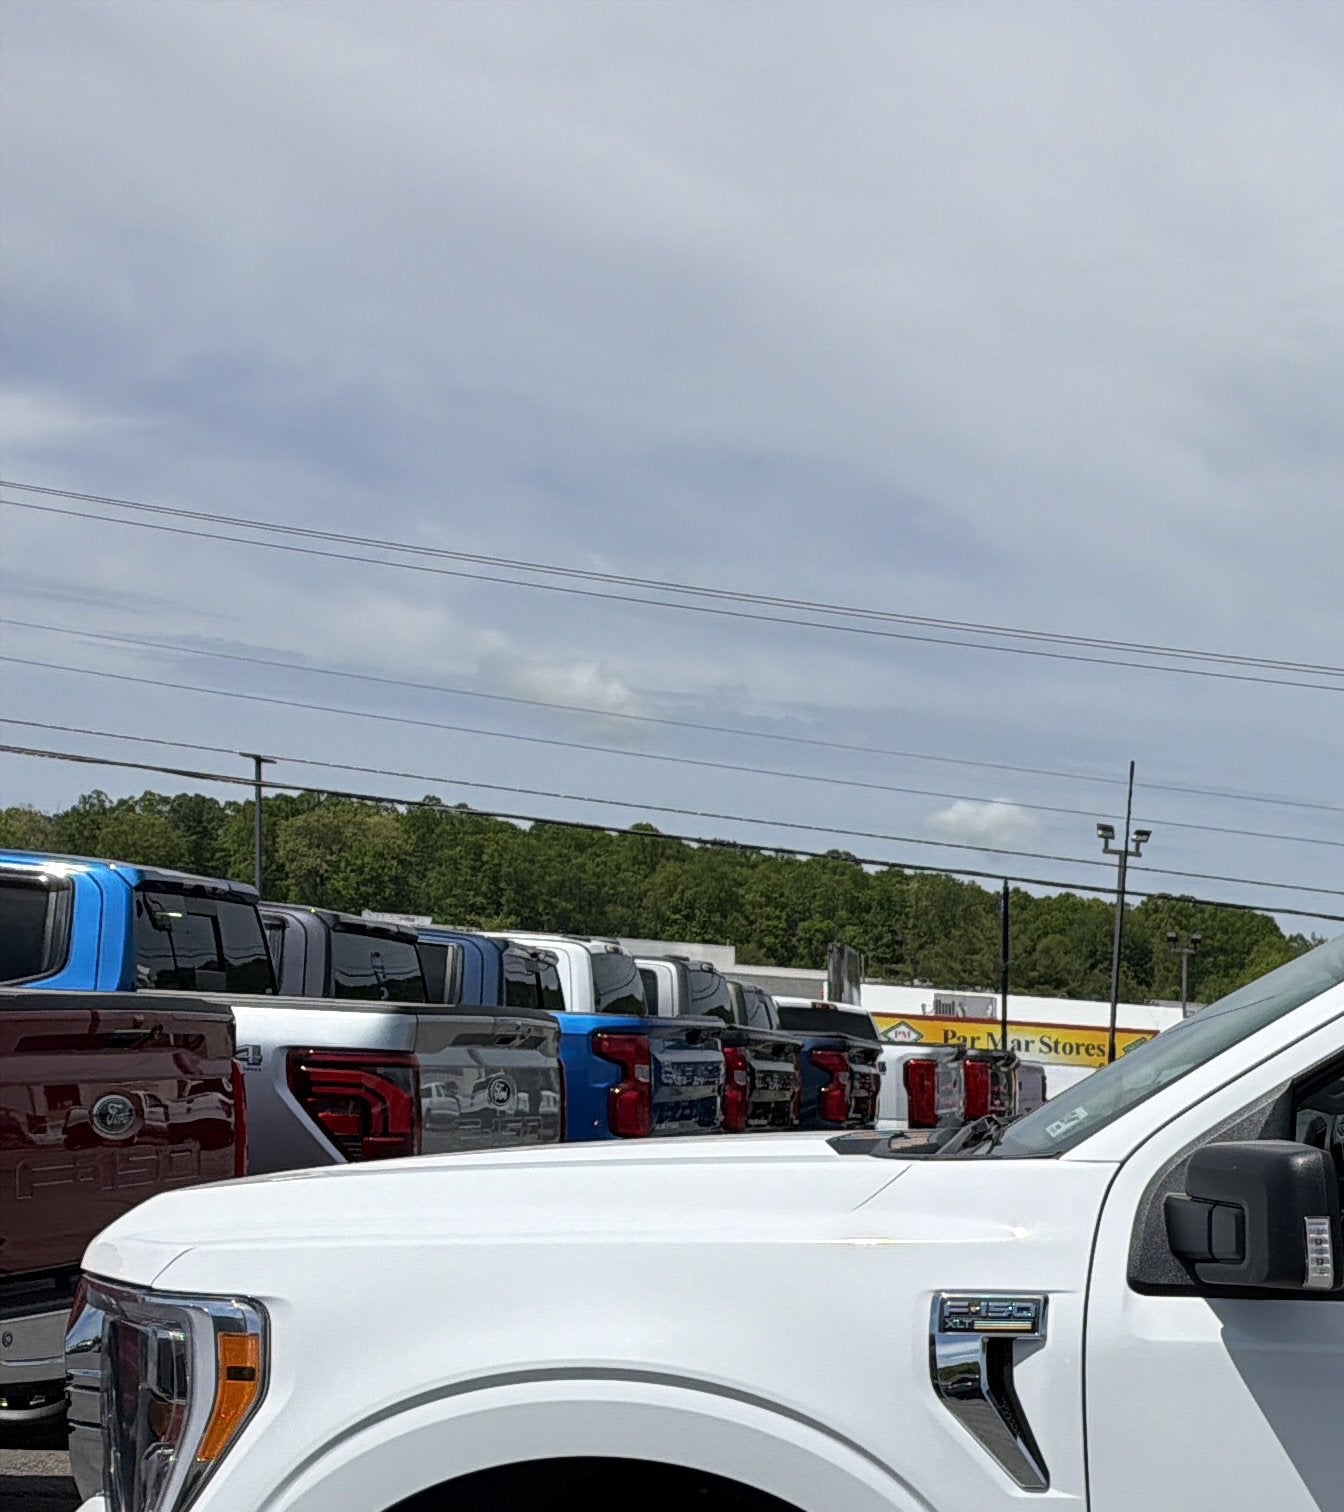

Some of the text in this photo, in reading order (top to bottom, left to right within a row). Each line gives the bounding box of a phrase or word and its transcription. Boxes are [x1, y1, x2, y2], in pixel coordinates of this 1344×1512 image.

[894, 1030, 911, 1040] PM
[943, 1029, 981, 1049] Par
[1039, 1035, 1106, 1058] Stores
[943, 1301, 1036, 1318] F-150
[944, 1319, 973, 1329] XLT
